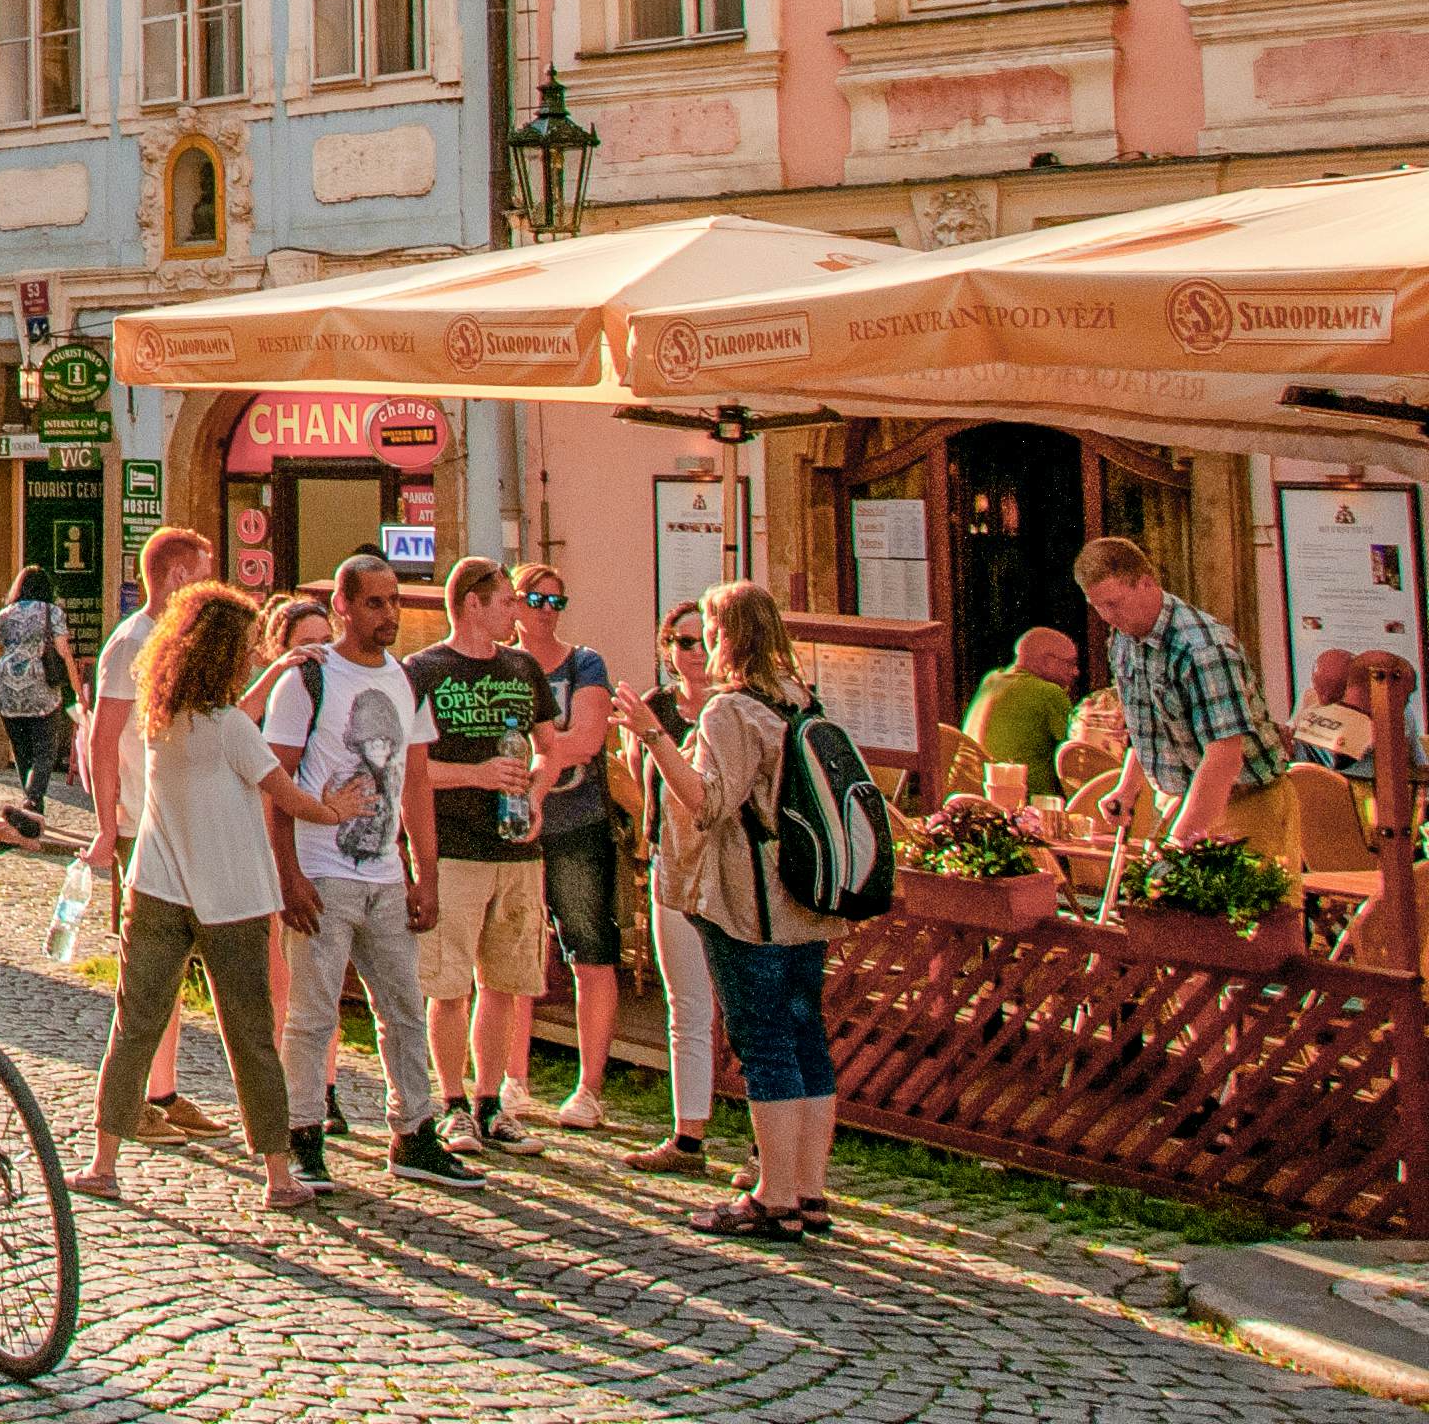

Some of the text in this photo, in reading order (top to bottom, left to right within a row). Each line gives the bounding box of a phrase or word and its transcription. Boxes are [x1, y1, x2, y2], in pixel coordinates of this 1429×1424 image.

[27, 283, 40, 297] 53
[848, 301, 1118, 342] RESTAURANT POD VĚŽÍ
[1236, 301, 1383, 331] STAROPRAMEN
[166, 336, 231, 359] STAROPRAMEN
[255, 331, 416, 354] RESTAURANT POD VĚŽÍ
[486, 331, 571, 355] STAROPRAMEN
[704, 328, 802, 360] STAROPRAMEN
[47, 349, 102, 367] TOURIST INFO
[378, 402, 436, 423] change
[60, 448, 91, 467] WC
[28, 481, 72, 497] TOURIST
[123, 499, 161, 515] HOSTEL
[435, 674, 530, 694] Los Angeles
[436, 692, 489, 709] OPEN
[452, 708, 509, 724] NIGHT
